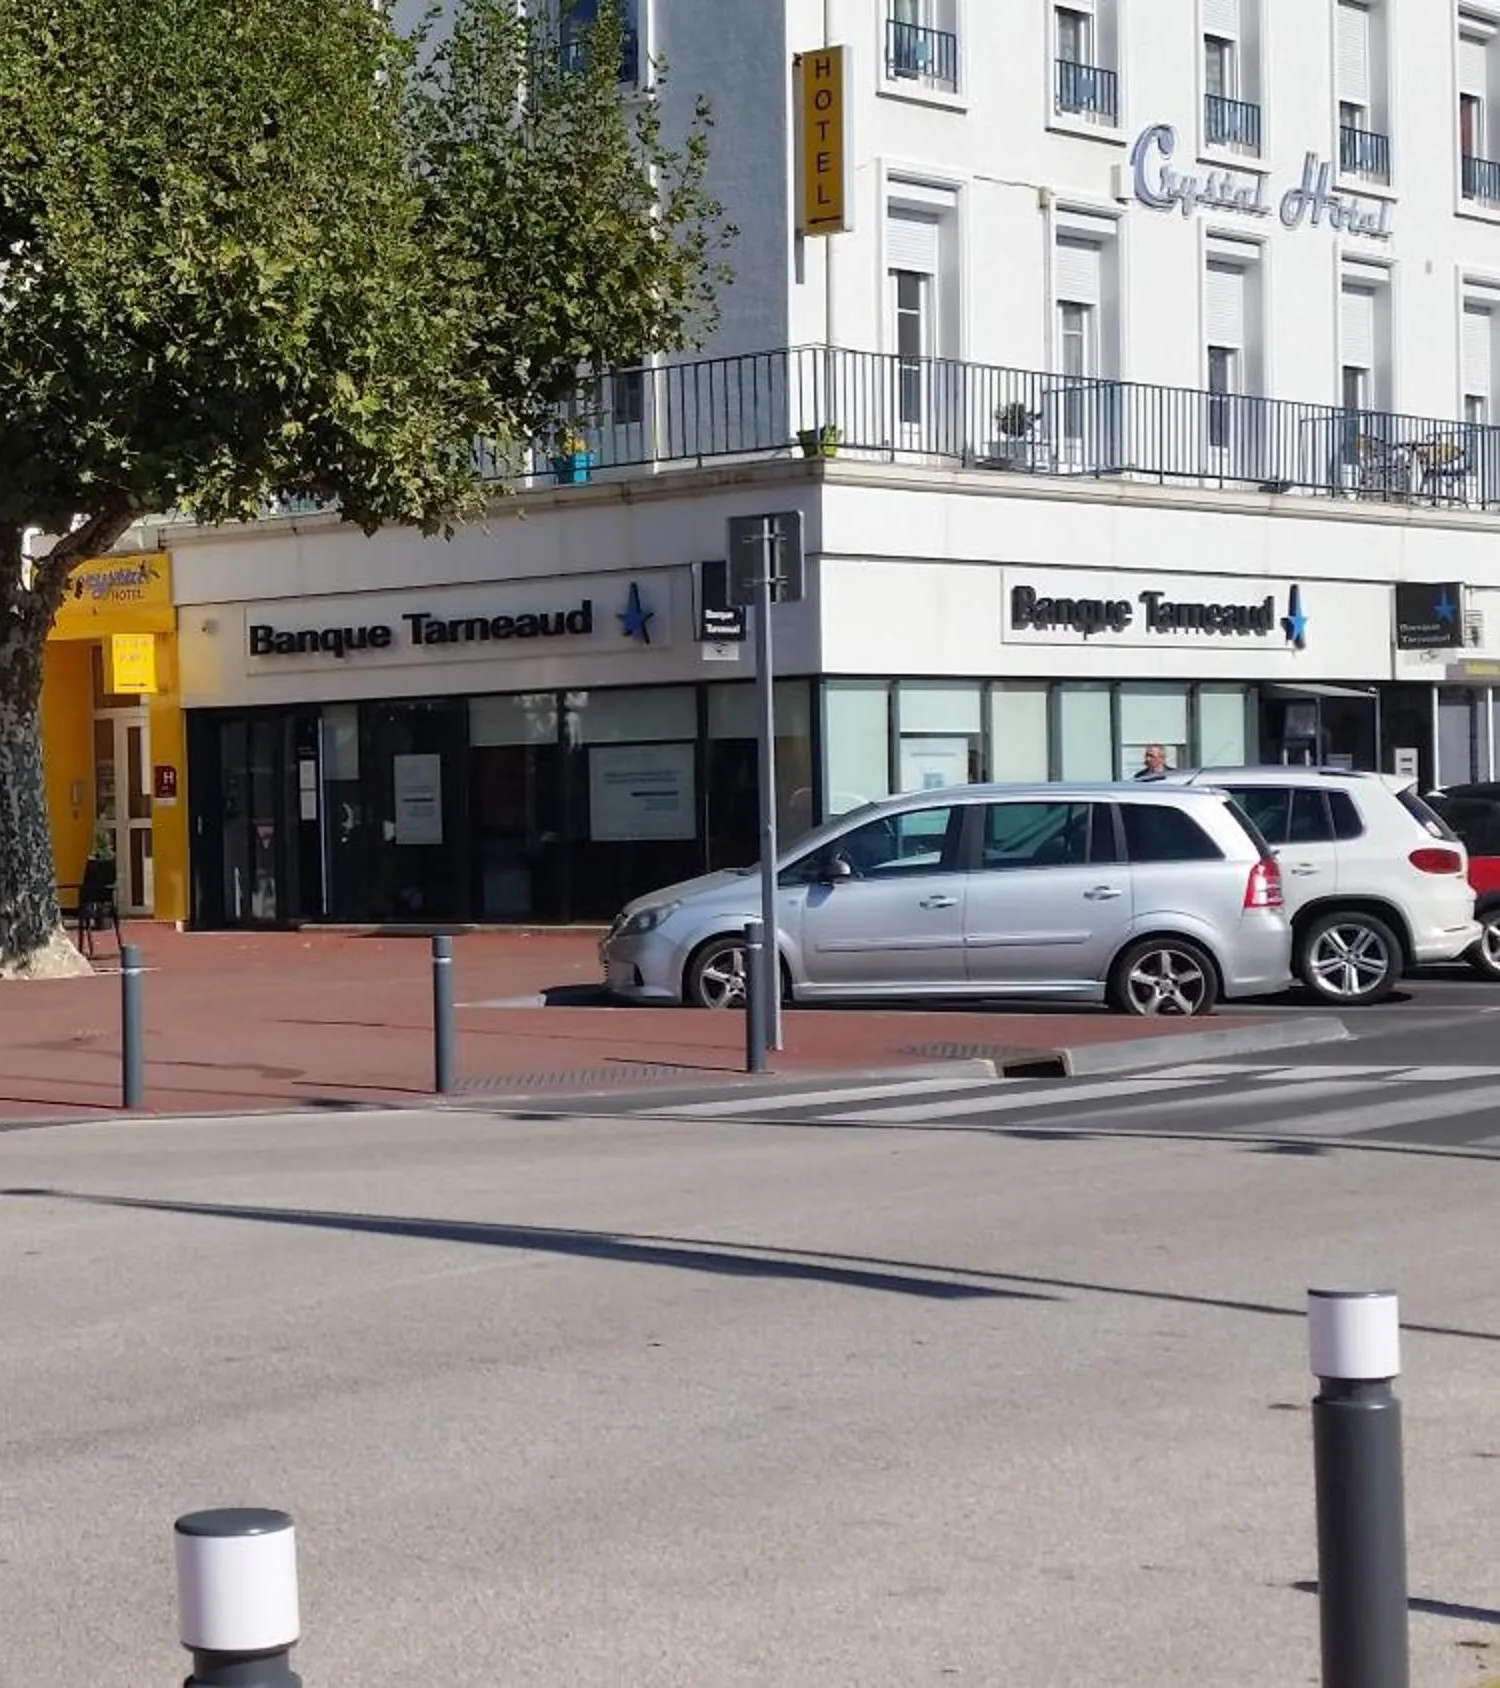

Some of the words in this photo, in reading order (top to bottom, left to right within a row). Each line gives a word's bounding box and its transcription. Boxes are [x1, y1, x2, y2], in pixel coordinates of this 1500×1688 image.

[815, 56, 832, 205] HOTEL
[1130, 124, 1273, 218] Crystal
[249, 625, 392, 657] Banque
[402, 600, 593, 645] Tarneaud
[1011, 585, 1133, 640] Banque
[1139, 590, 1275, 636] Tarneaud
[163, 771, 175, 785] H
